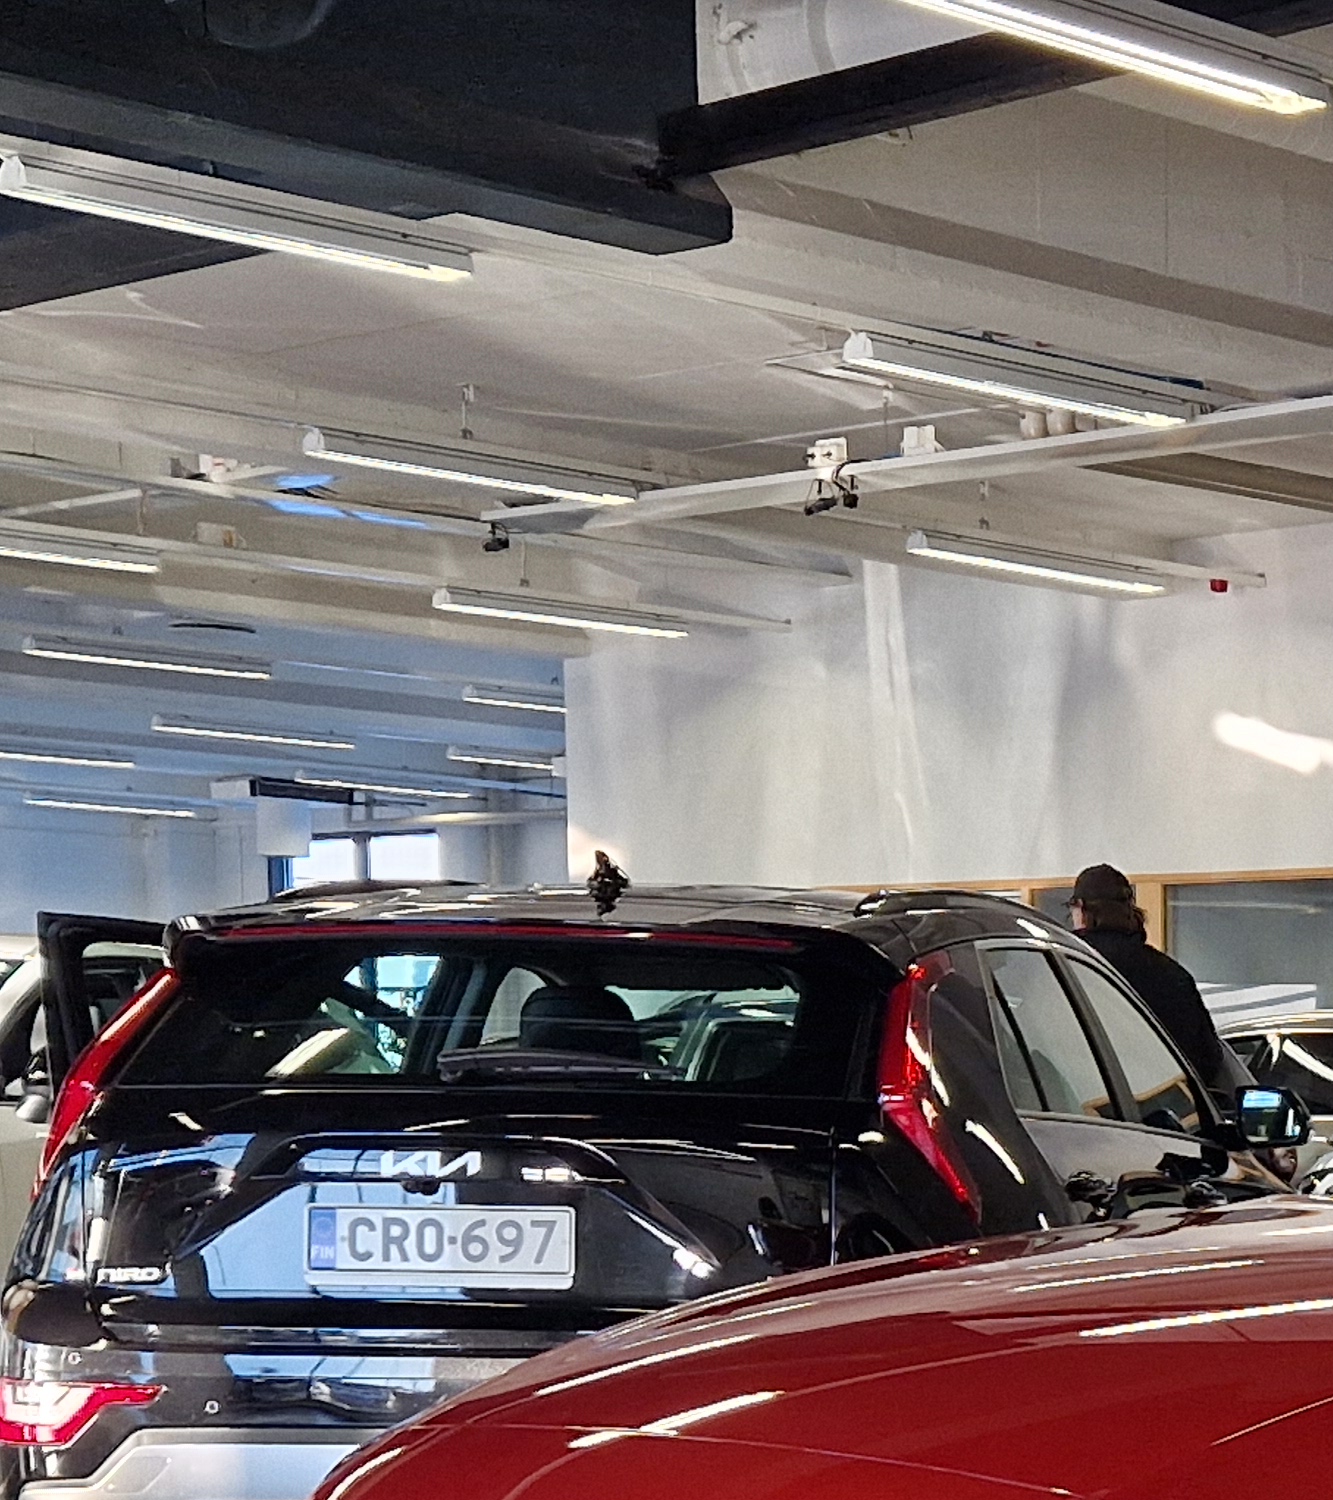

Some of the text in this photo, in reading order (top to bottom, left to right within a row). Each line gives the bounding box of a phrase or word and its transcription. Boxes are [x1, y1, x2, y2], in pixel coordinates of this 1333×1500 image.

[380, 1151, 482, 1178] KIA
[311, 1245, 335, 1260] FIN
[347, 1216, 558, 1265] CRO-697
